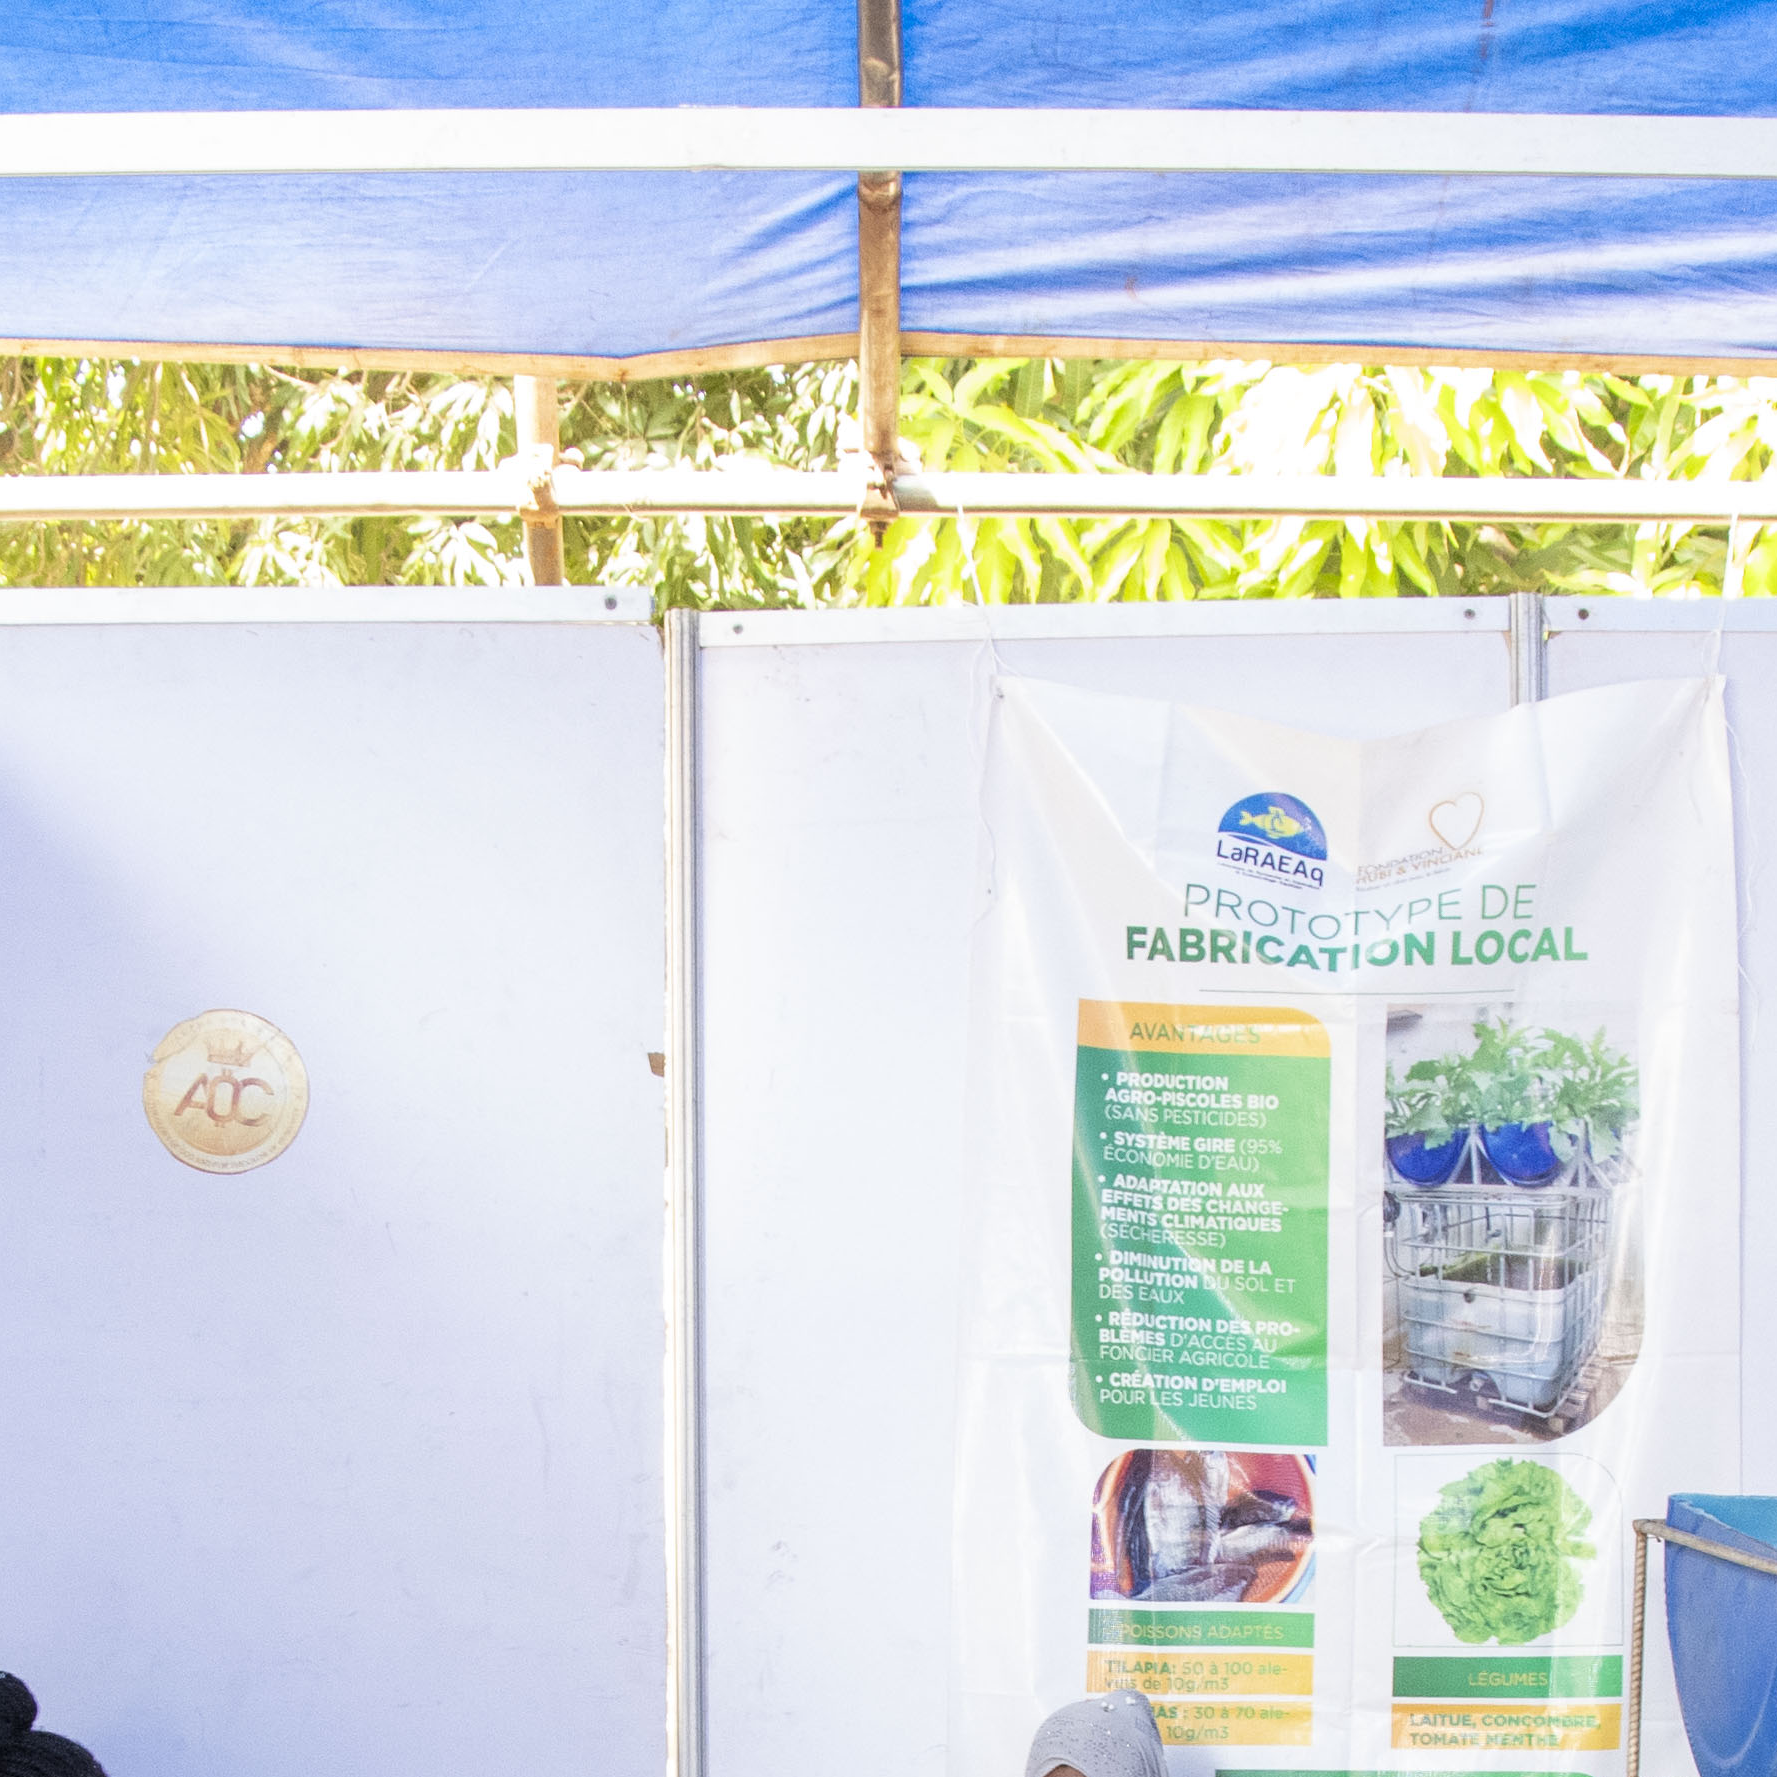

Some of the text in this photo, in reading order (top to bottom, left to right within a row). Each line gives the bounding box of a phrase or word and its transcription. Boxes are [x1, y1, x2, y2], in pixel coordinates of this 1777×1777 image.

[1216, 838, 1324, 887] LaRAEAq
[1184, 883, 1538, 940] PROTOTYPE DE
[1126, 926, 1589, 972] FABRICATION LOCAL
[1130, 1023, 1261, 1045] AVANTAGES
[1116, 1072, 1228, 1091] PRODUCTION
[1105, 1087, 1279, 1110] AGRO-PISCOLES BIO
[1104, 1105, 1266, 1128] (SANS PESTICIDES)
[1114, 1131, 1283, 1155] SYSTÈME GIRE (95%
[1103, 1143, 1259, 1172] ÉCONOMIE D'EAU)
[1113, 1174, 1265, 1198] ADAPTATION AUX
[1102, 1189, 1289, 1216] EFFETS DES CHANGE-
[1101, 1205, 1282, 1233] MENTS CLIMATIQUES
[1109, 1250, 1272, 1275] DIMINUTION DE LA
[1098, 1267, 1296, 1294] POLLUTION DU SOL ET
[1098, 1284, 1185, 1304] DES EAUX
[1109, 1308, 1301, 1337] RÉDUCTION DES PRO-
[1099, 1345, 1270, 1370] FONCIER AGRICOLE
[1252, 1338, 1277, 1353] AU
[1109, 1369, 1287, 1395] CRÉATION D'EMPLOI
[1099, 1387, 1257, 1411] POUR LES JEUNES
[1121, 1623, 1202, 1640] POISSONS
[1182, 1661, 1204, 1676] 50
[1210, 1659, 1219, 1676] à
[1225, 1661, 1253, 1676] 100
[1258, 1661, 1287, 1676] ale-
[1467, 1671, 1548, 1687] LÉGUMES
[1142, 1676, 1161, 1691] de
[1166, 1677, 1230, 1694] 10g/m3
[1194, 1706, 1214, 1719] 30
[1220, 1705, 1230, 1719] à
[1236, 1706, 1255, 1719] 70
[1410, 1713, 1477, 1729] LAITUE,
[1166, 1725, 1230, 1742] 10g/m3
